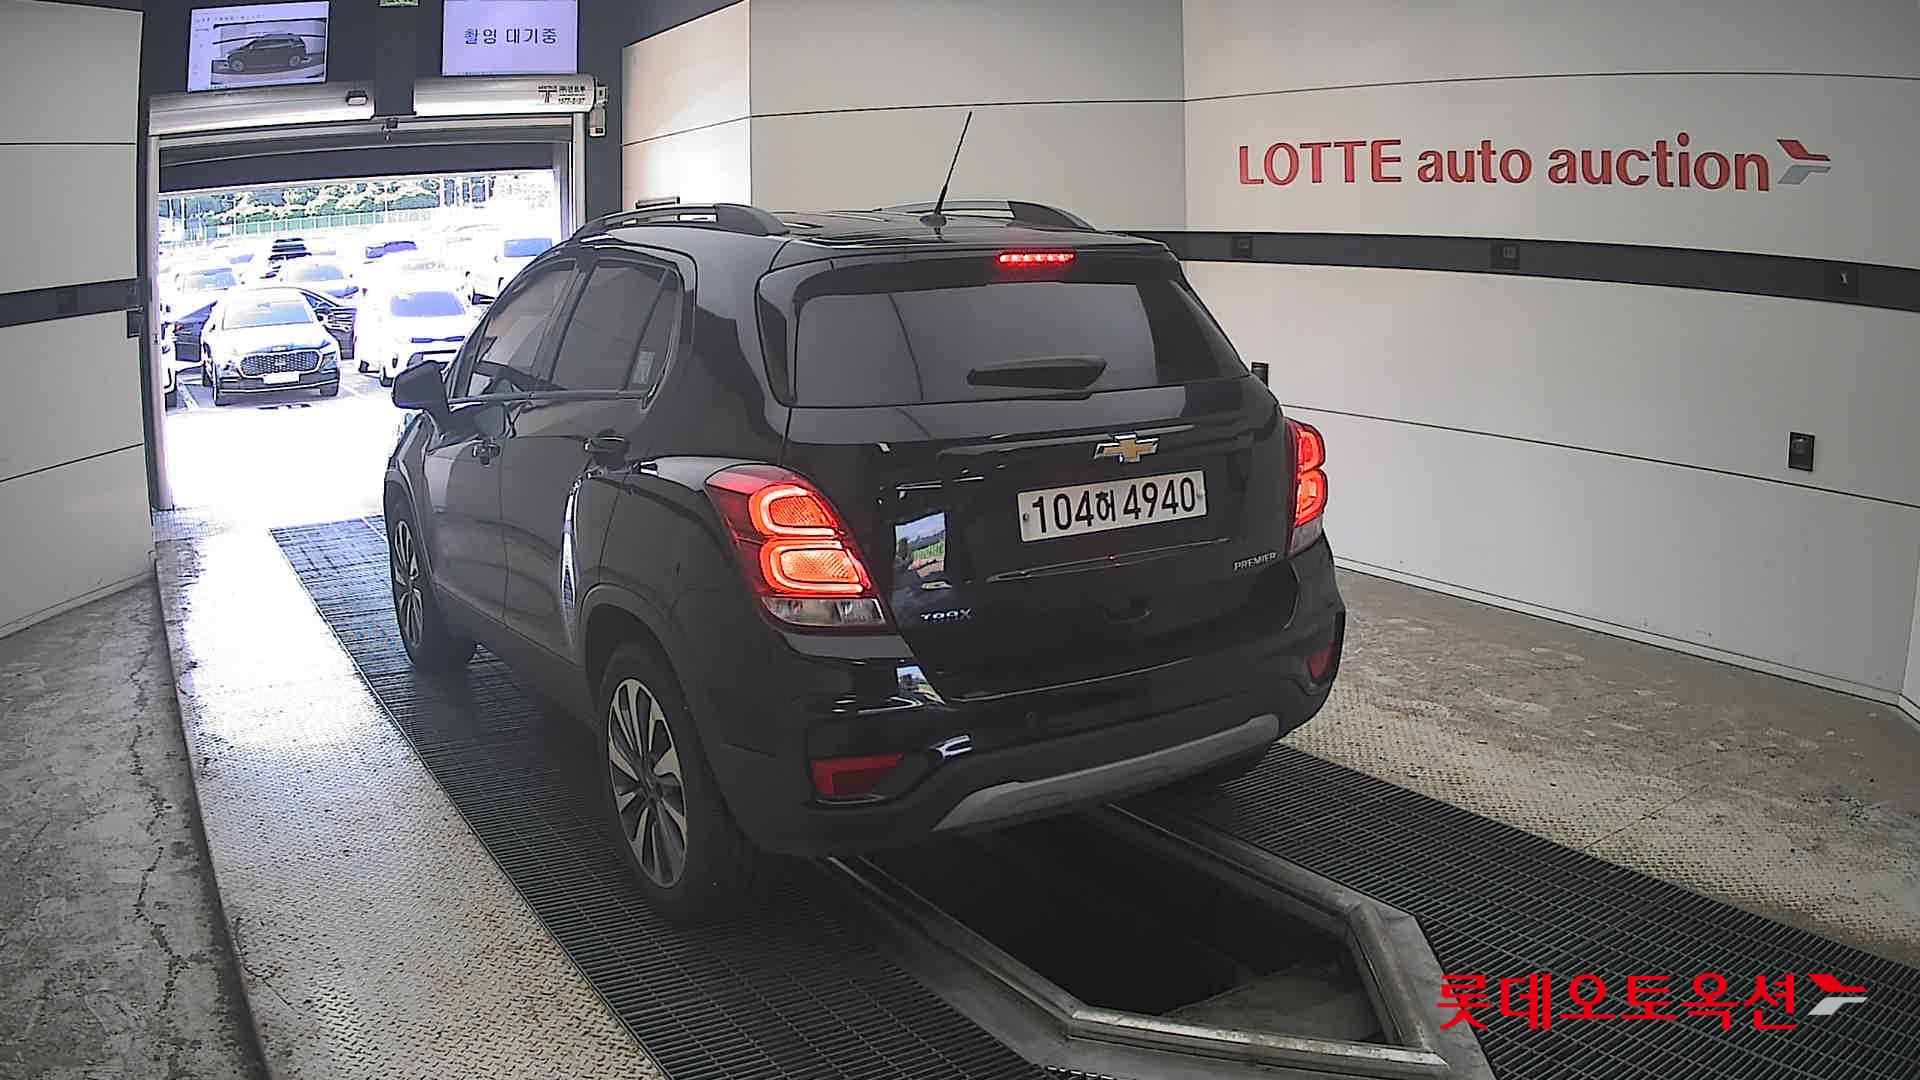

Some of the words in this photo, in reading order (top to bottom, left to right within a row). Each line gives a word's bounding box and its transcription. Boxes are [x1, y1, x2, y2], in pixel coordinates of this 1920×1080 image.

[506, 28, 558, 45] 대기중
[1239, 139, 1402, 185] LOTTE
[1417, 139, 1532, 186] auto
[1548, 132, 1770, 191] auction
[1032, 488, 1115, 533] 104허
[1122, 476, 1196, 520] 4940
[1234, 551, 1277, 571] PREMIER
